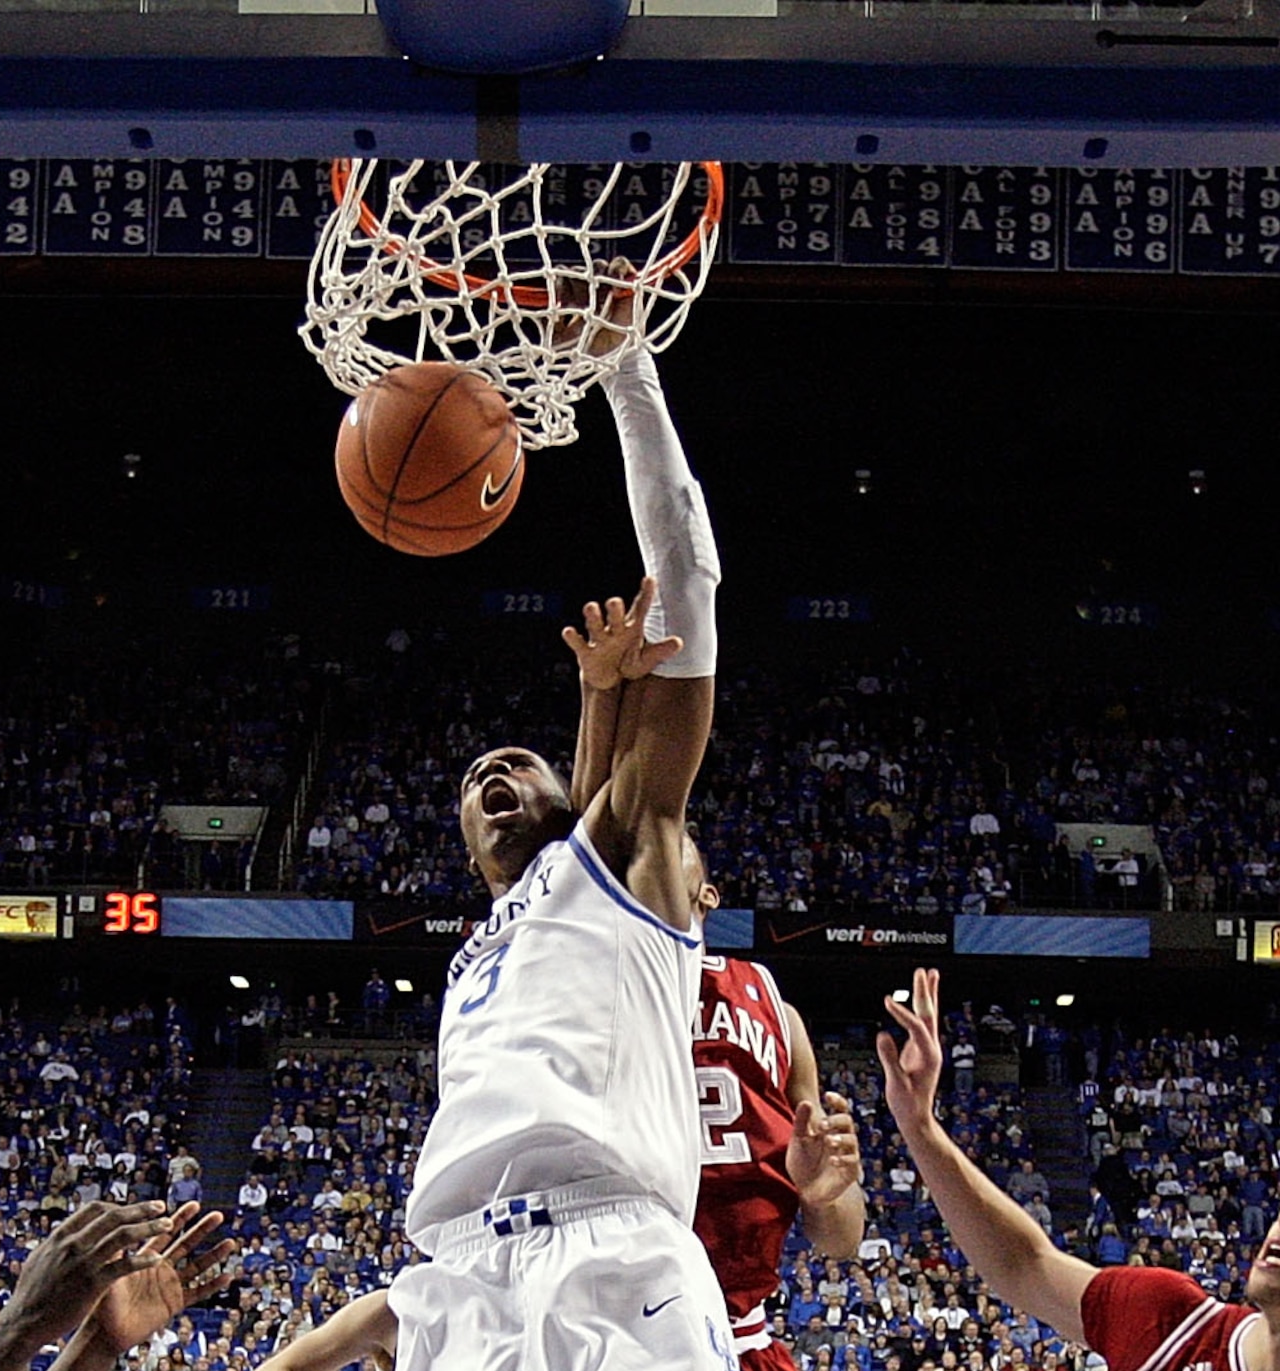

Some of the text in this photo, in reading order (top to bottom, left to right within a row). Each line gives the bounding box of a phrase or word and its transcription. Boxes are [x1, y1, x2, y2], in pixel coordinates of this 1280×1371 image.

[105, 893, 158, 934] 35
[826, 925, 898, 947] verizon
[459, 943, 511, 1014] 3
[694, 1066, 752, 1165] 2
